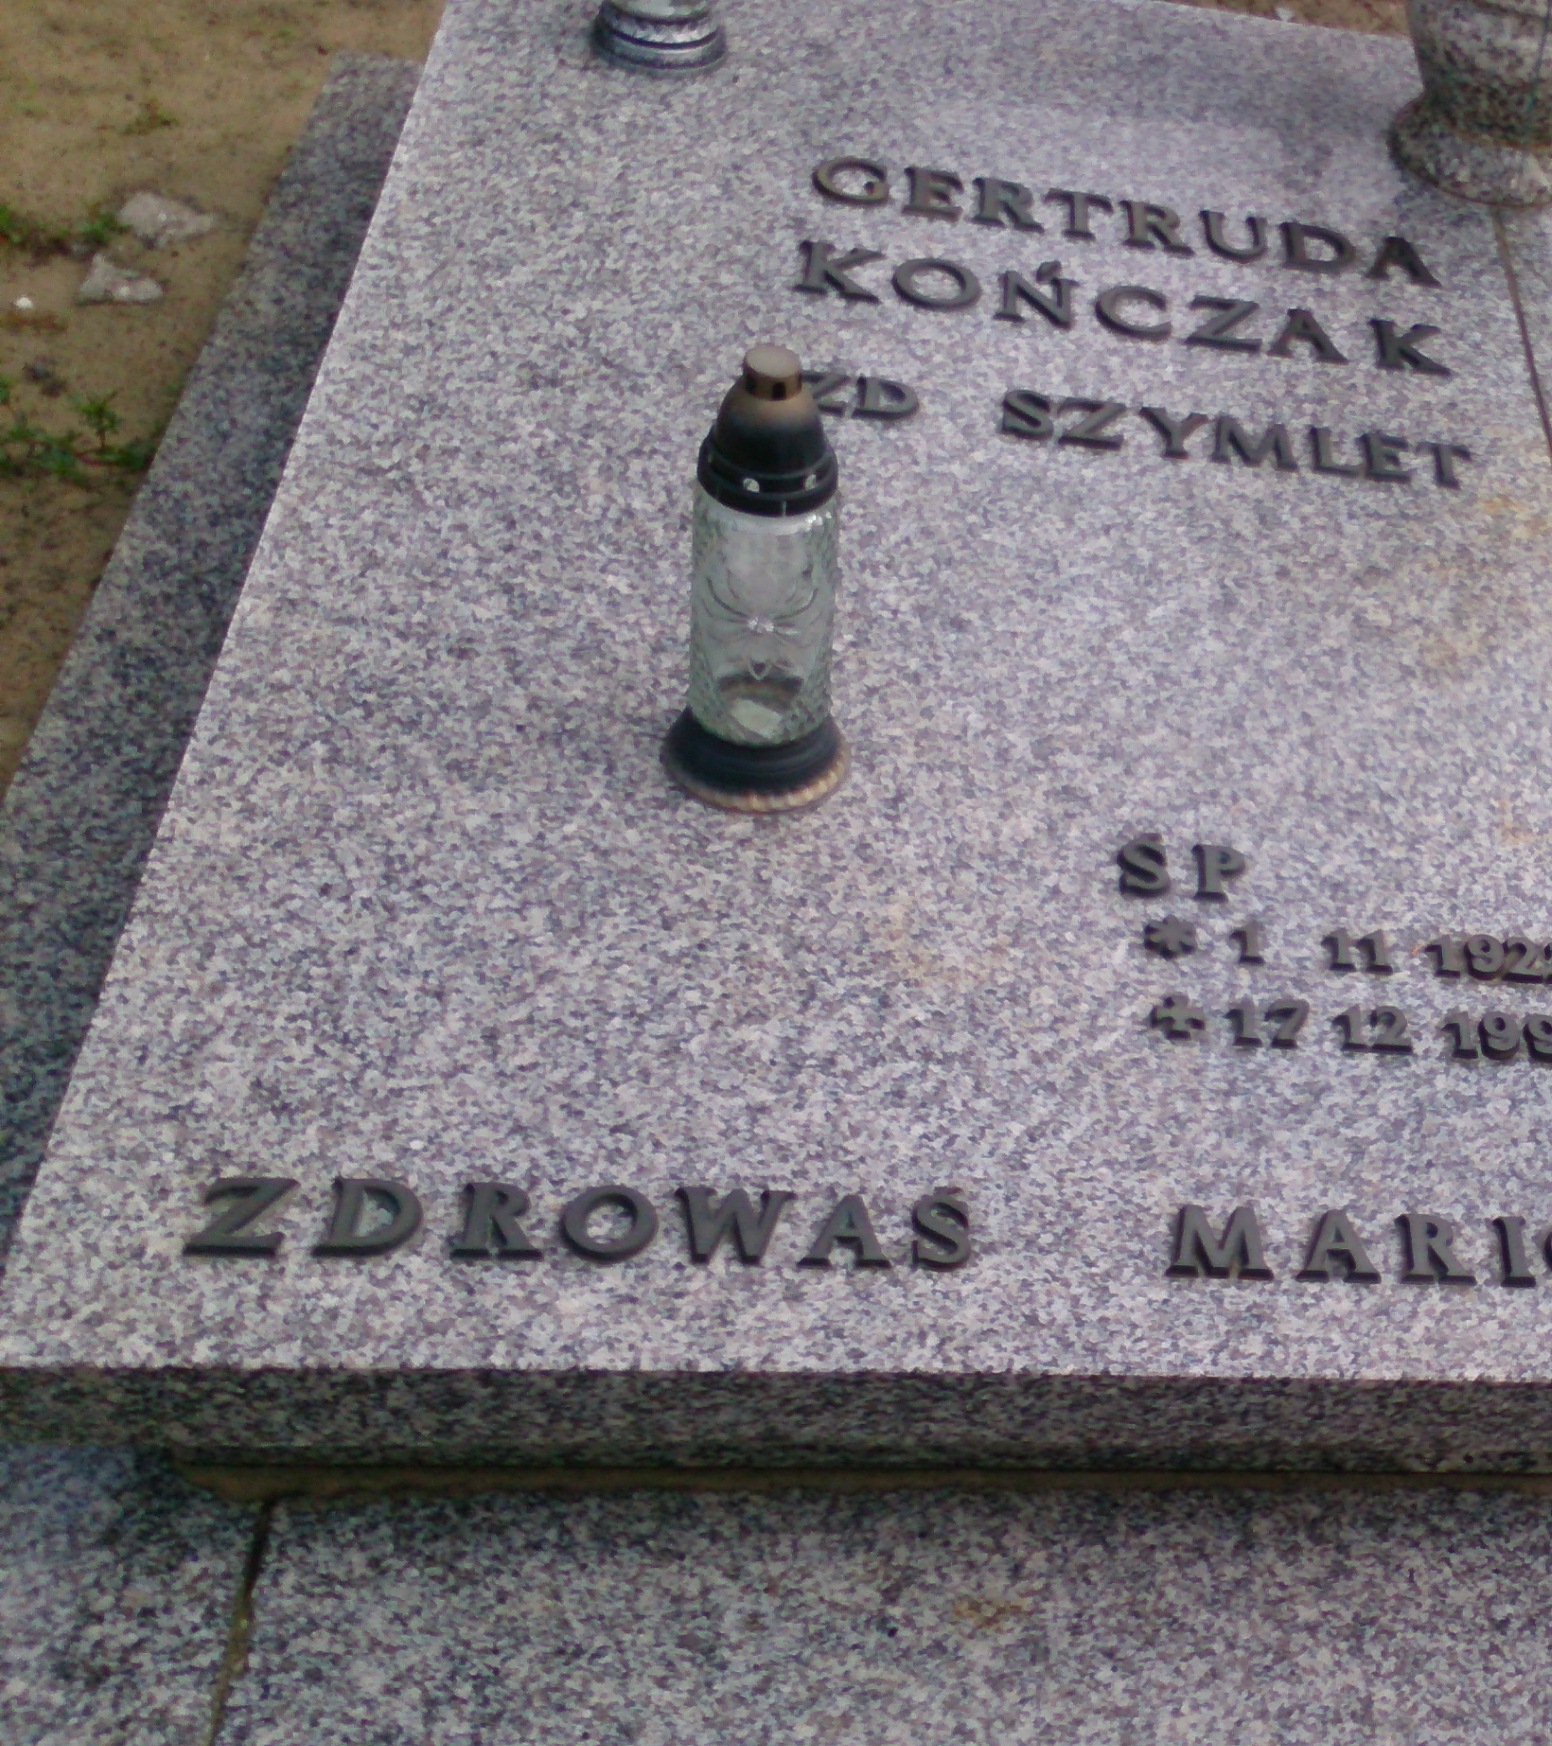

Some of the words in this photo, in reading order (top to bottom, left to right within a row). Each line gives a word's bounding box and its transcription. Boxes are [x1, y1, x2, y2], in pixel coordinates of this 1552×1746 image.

[812, 156, 1441, 288] GERTRUDA
[792, 240, 1452, 377] KOŃCZAK
[1000, 390, 1472, 490] SZYMLET
[1322, 928, 1393, 975] 11
[1226, 1000, 1311, 1049] 17
[1331, 1004, 1413, 1055] 12
